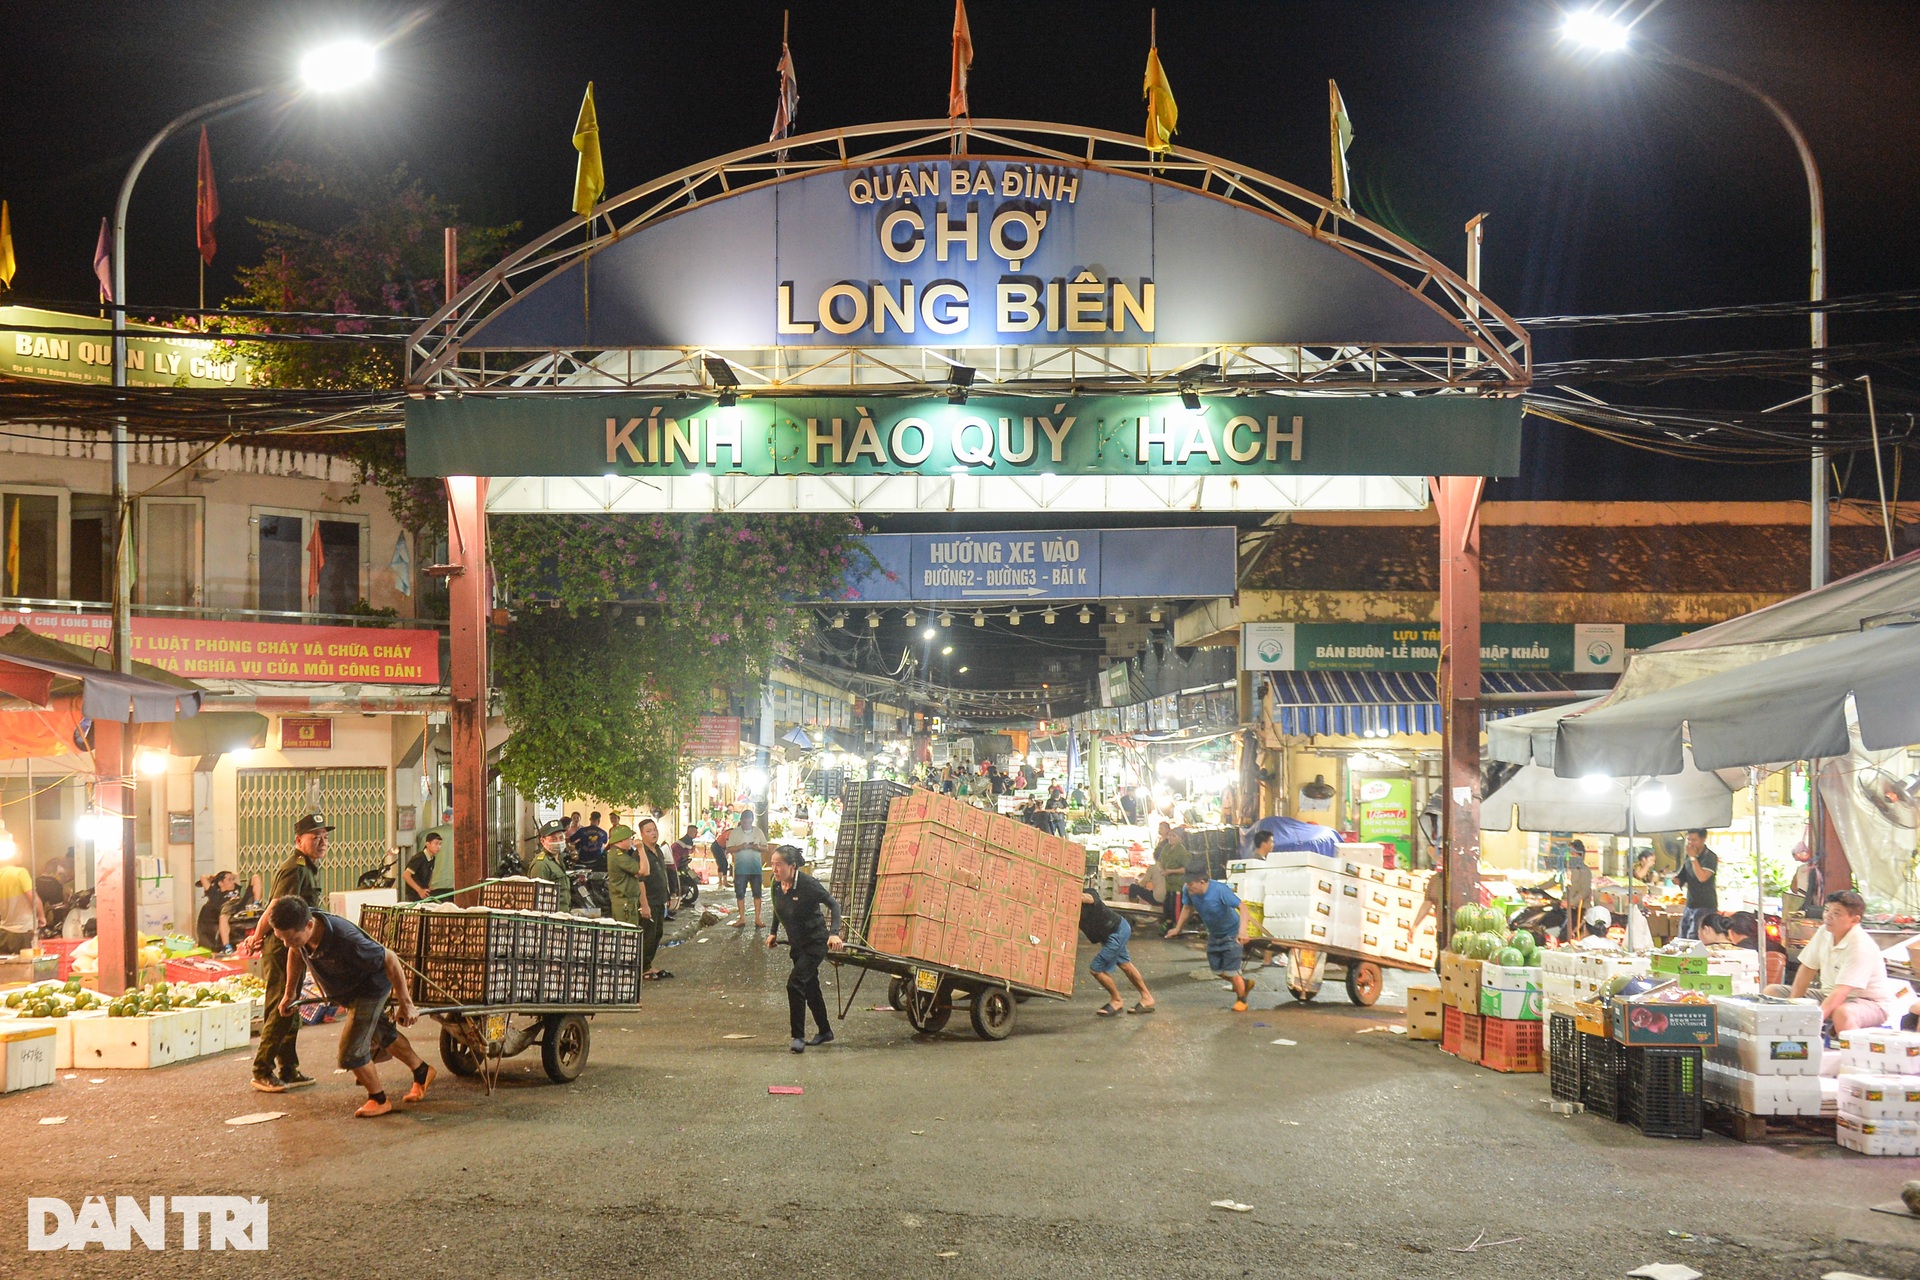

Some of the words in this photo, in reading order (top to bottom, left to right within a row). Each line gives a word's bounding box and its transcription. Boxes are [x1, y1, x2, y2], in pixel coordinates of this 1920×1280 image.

[849, 168, 940, 204] QUẬN
[951, 169, 995, 196] BA
[1001, 165, 1079, 204] ĐÌNH
[880, 210, 1048, 272] CHỢ
[778, 283, 970, 335] LONG
[996, 271, 1155, 333] BIÊN
[15, 334, 70, 361] BAN
[78, 340, 145, 371] QUN
[154, 350, 182, 375] LÝ
[189, 357, 238, 386] CHỢ
[605, 406, 743, 463] KÍNH
[767, 406, 935, 464] HÀO
[950, 403, 1078, 468] QUÝ
[1098, 404, 1303, 463] HÁCH
[930, 536, 1002, 564] HƯỚNG
[1008, 541, 1035, 564] XE
[1041, 536, 1080, 563] VÀO
[923, 564, 974, 587] ĐƯỜNG2
[986, 564, 1037, 586] ĐƯỜNG3
[1052, 564, 1074, 585] BÃI
[1077, 568, 1087, 585] K
[20, 615, 32, 626] LÝ
[35, 616, 58, 628] CHỢ
[61, 618, 89, 628] LONG
[148, 636, 190, 653] LUẬT
[195, 637, 252, 654] PHÒNG
[257, 640, 299, 655] CHÁY
[303, 641, 324, 656] VÀ
[328, 642, 369, 658] CHỮA
[373, 644, 412, 659] CHÁY
[1316, 644, 1345, 659] BÁN
[1411, 646, 1438, 659] HOA
[1480, 645, 1509, 661] HẬP
[1512, 640, 1549, 659] KHẨU
[157, 656, 180, 671] VÀ
[184, 658, 237, 673] NGHĨA
[241, 661, 262, 676] VỤ
[267, 658, 299, 675] CỦA
[304, 660, 334, 676] MỖI
[338, 663, 380, 678] CÔNG
[1397, 809, 1405, 819] C
